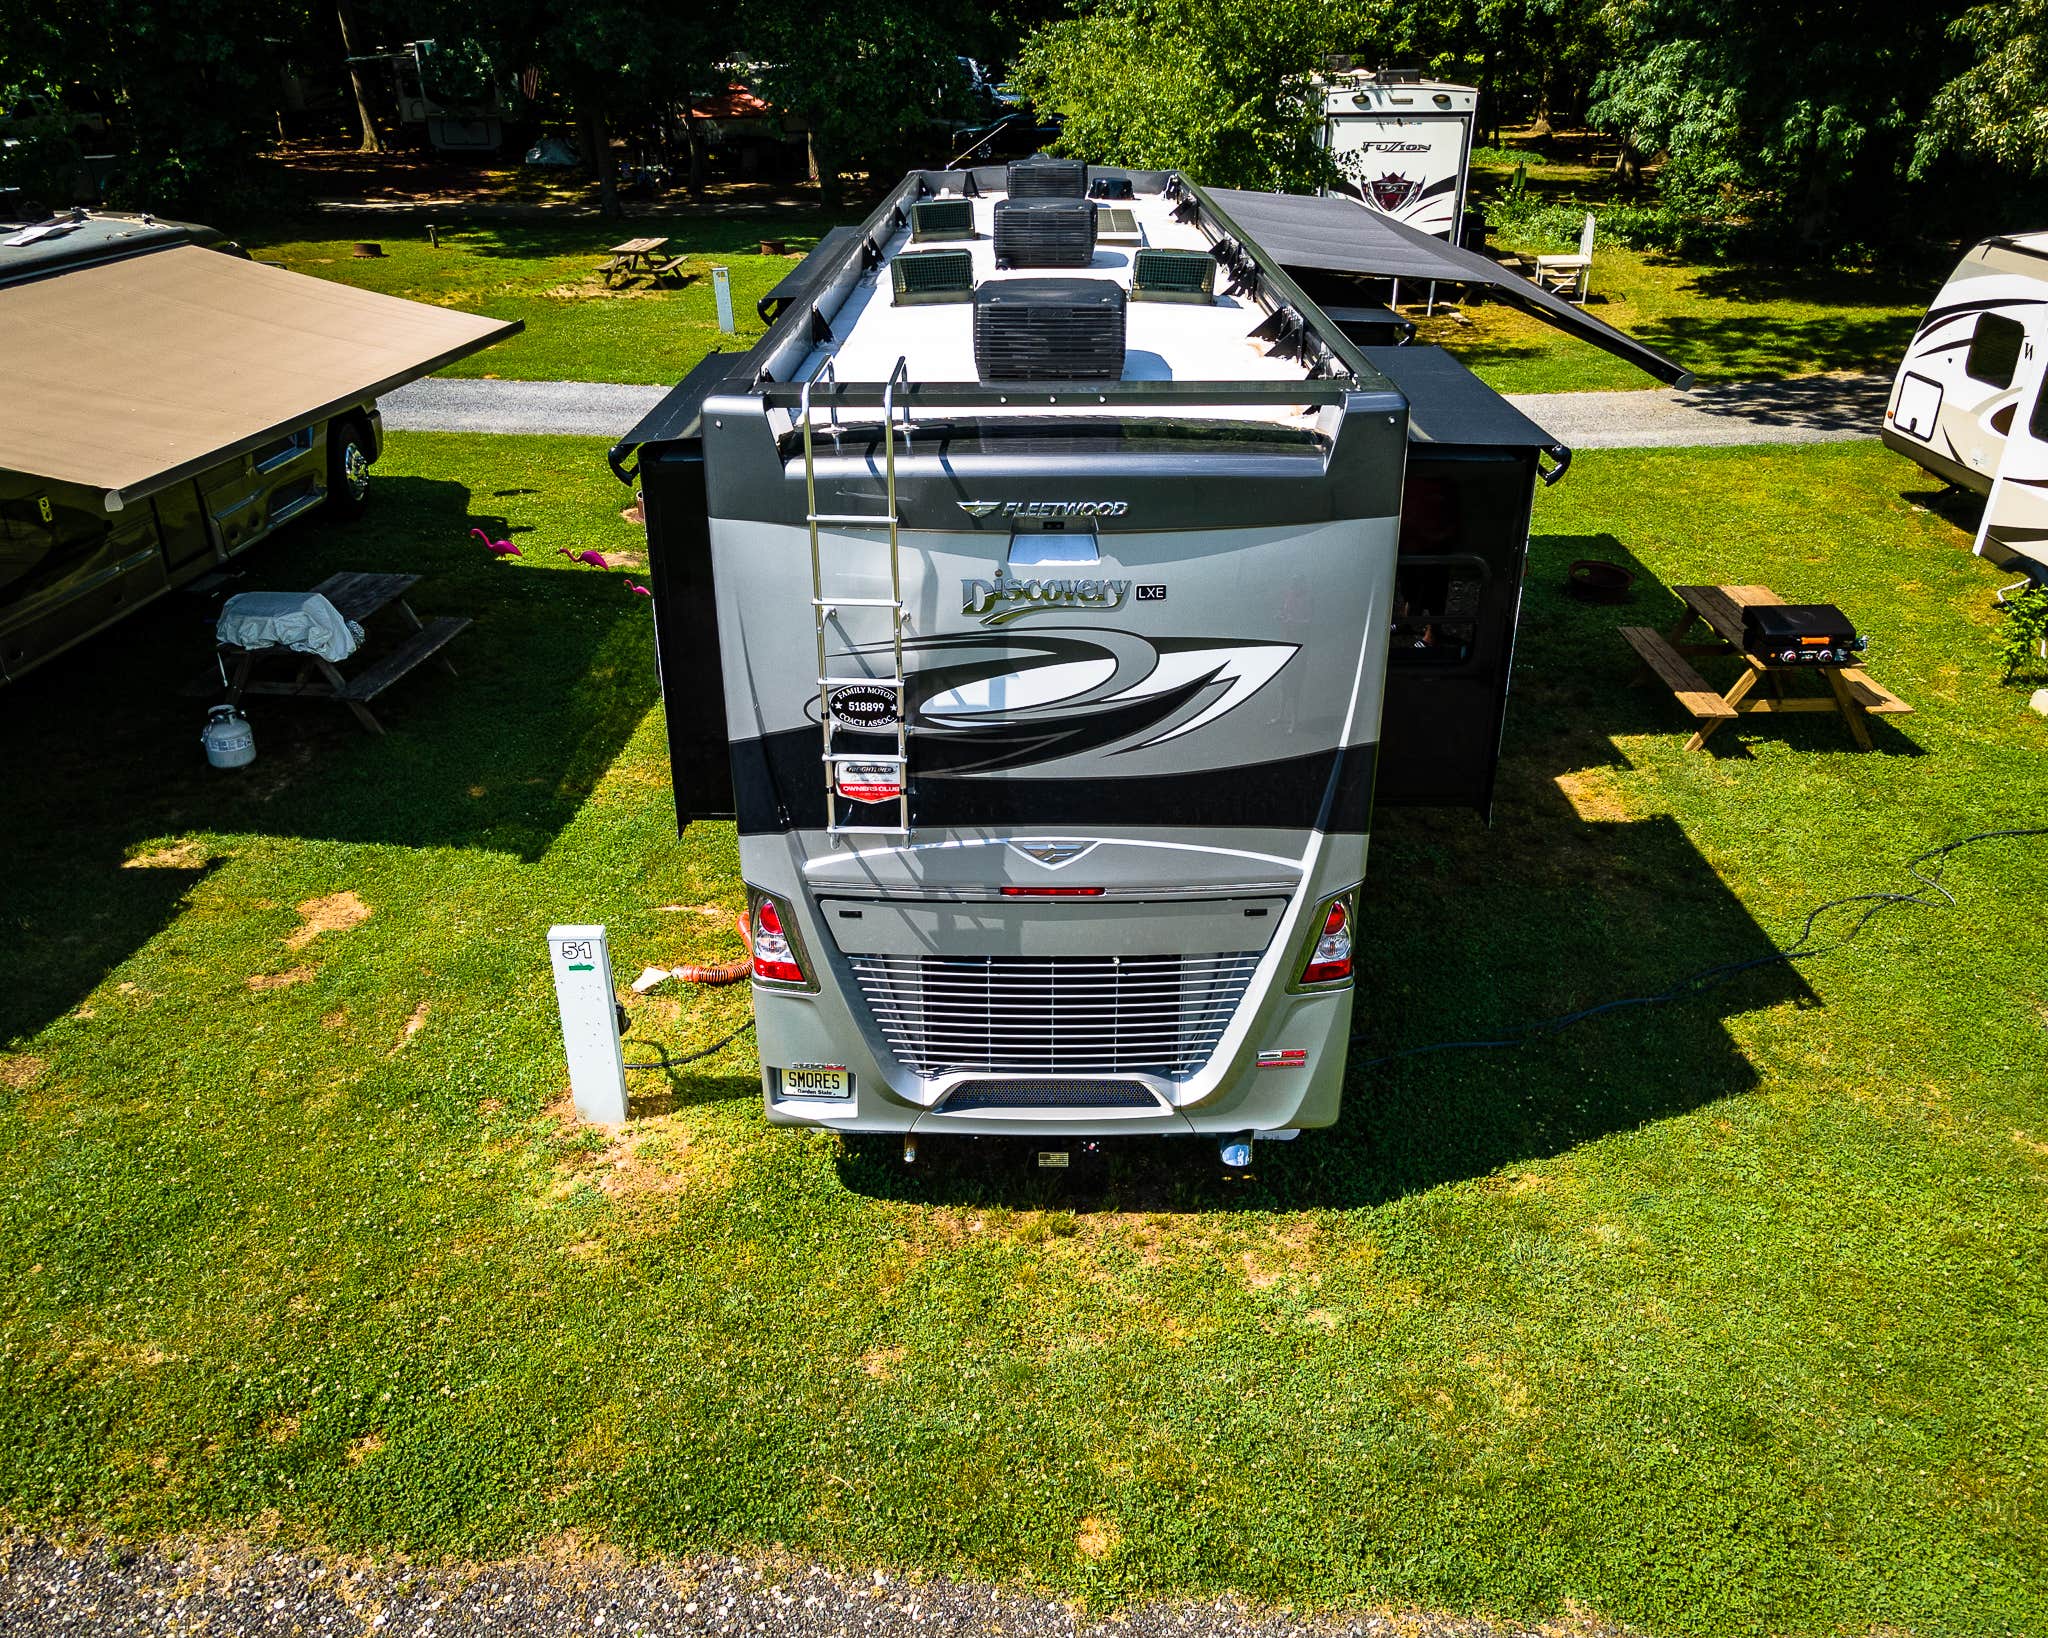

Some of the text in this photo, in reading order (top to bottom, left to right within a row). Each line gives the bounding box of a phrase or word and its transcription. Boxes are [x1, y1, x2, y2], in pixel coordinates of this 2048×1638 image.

[1002, 501, 1129, 518] FLEETWOOD
[960, 568, 1132, 625] Discovery
[1138, 587, 1164, 599] LXE
[837, 686, 895, 701] FAMILY MOTOR
[848, 701, 885, 712] 518899
[839, 712, 895, 727] COACH ASSOC.
[562, 941, 592, 960] 51
[788, 1071, 840, 1089] SMORES
